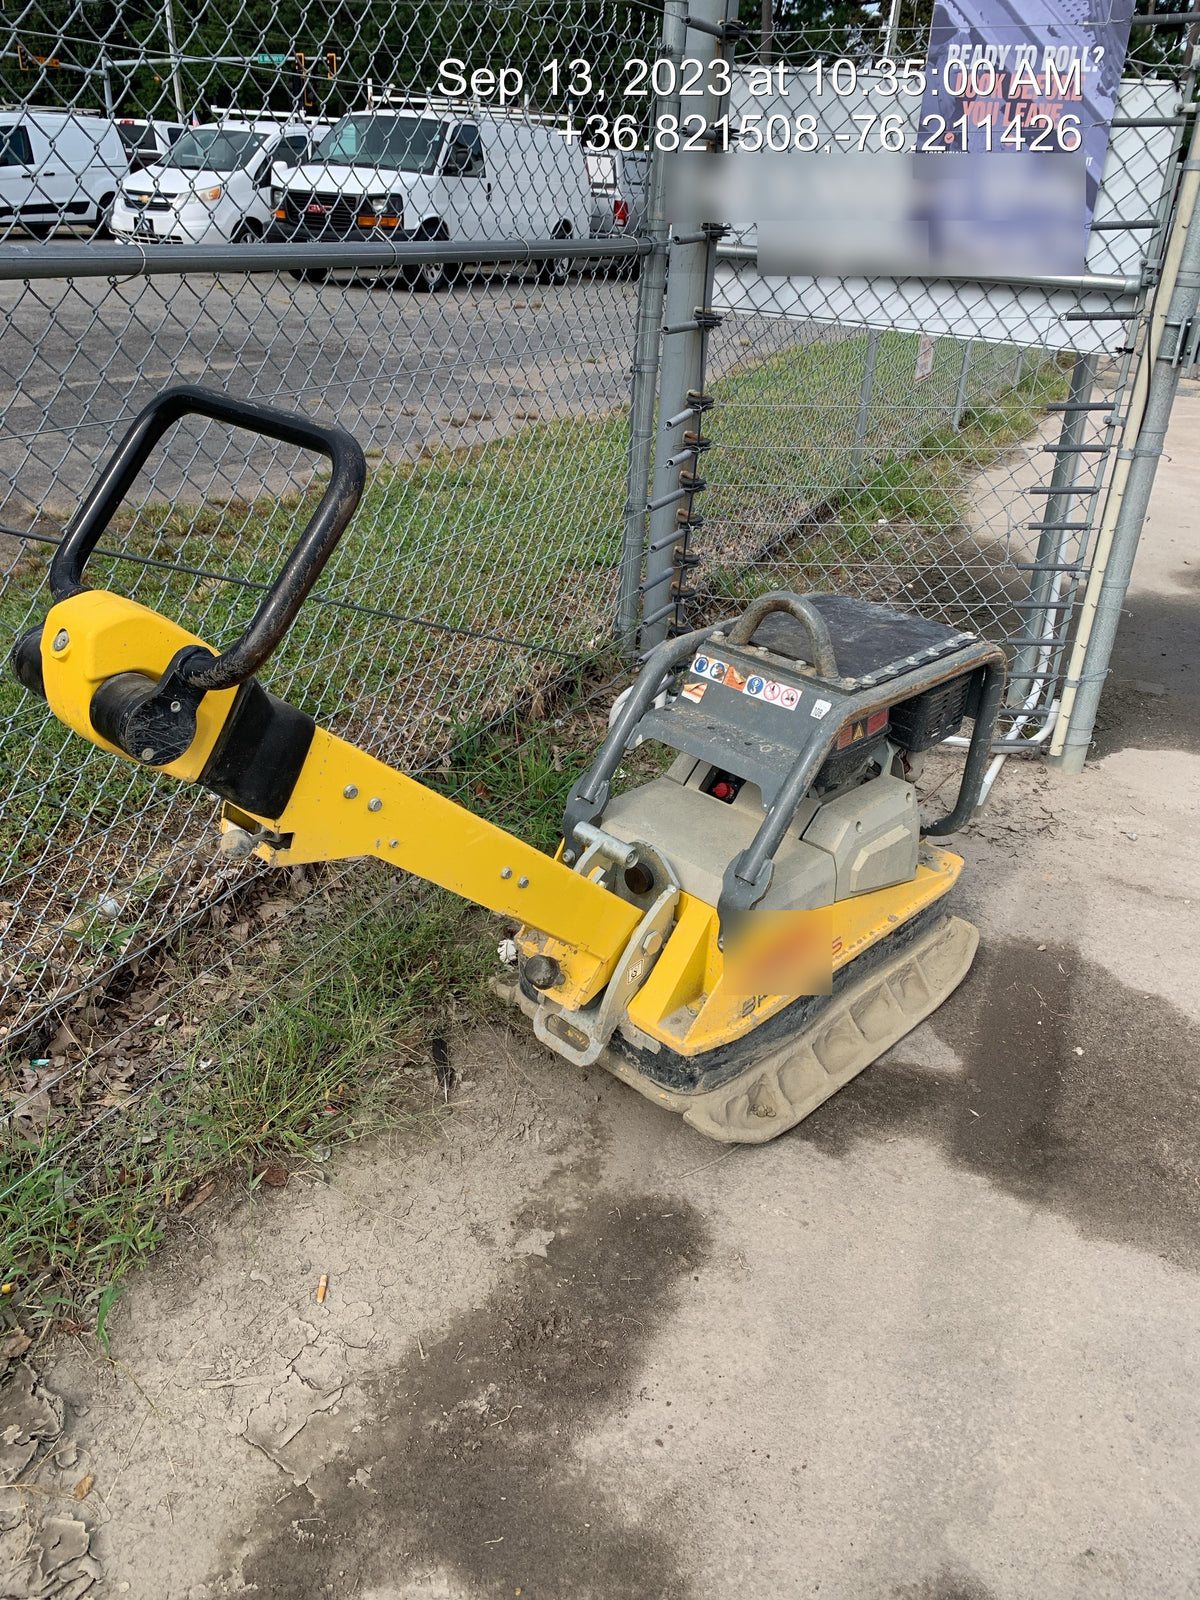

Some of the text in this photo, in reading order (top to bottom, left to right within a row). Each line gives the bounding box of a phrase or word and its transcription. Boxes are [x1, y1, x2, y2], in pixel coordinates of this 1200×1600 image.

[947, 43, 1105, 73] READY TO ROLL?
[955, 73, 1086, 101] LOOK BEFORE
[962, 101, 1000, 127] YOU
